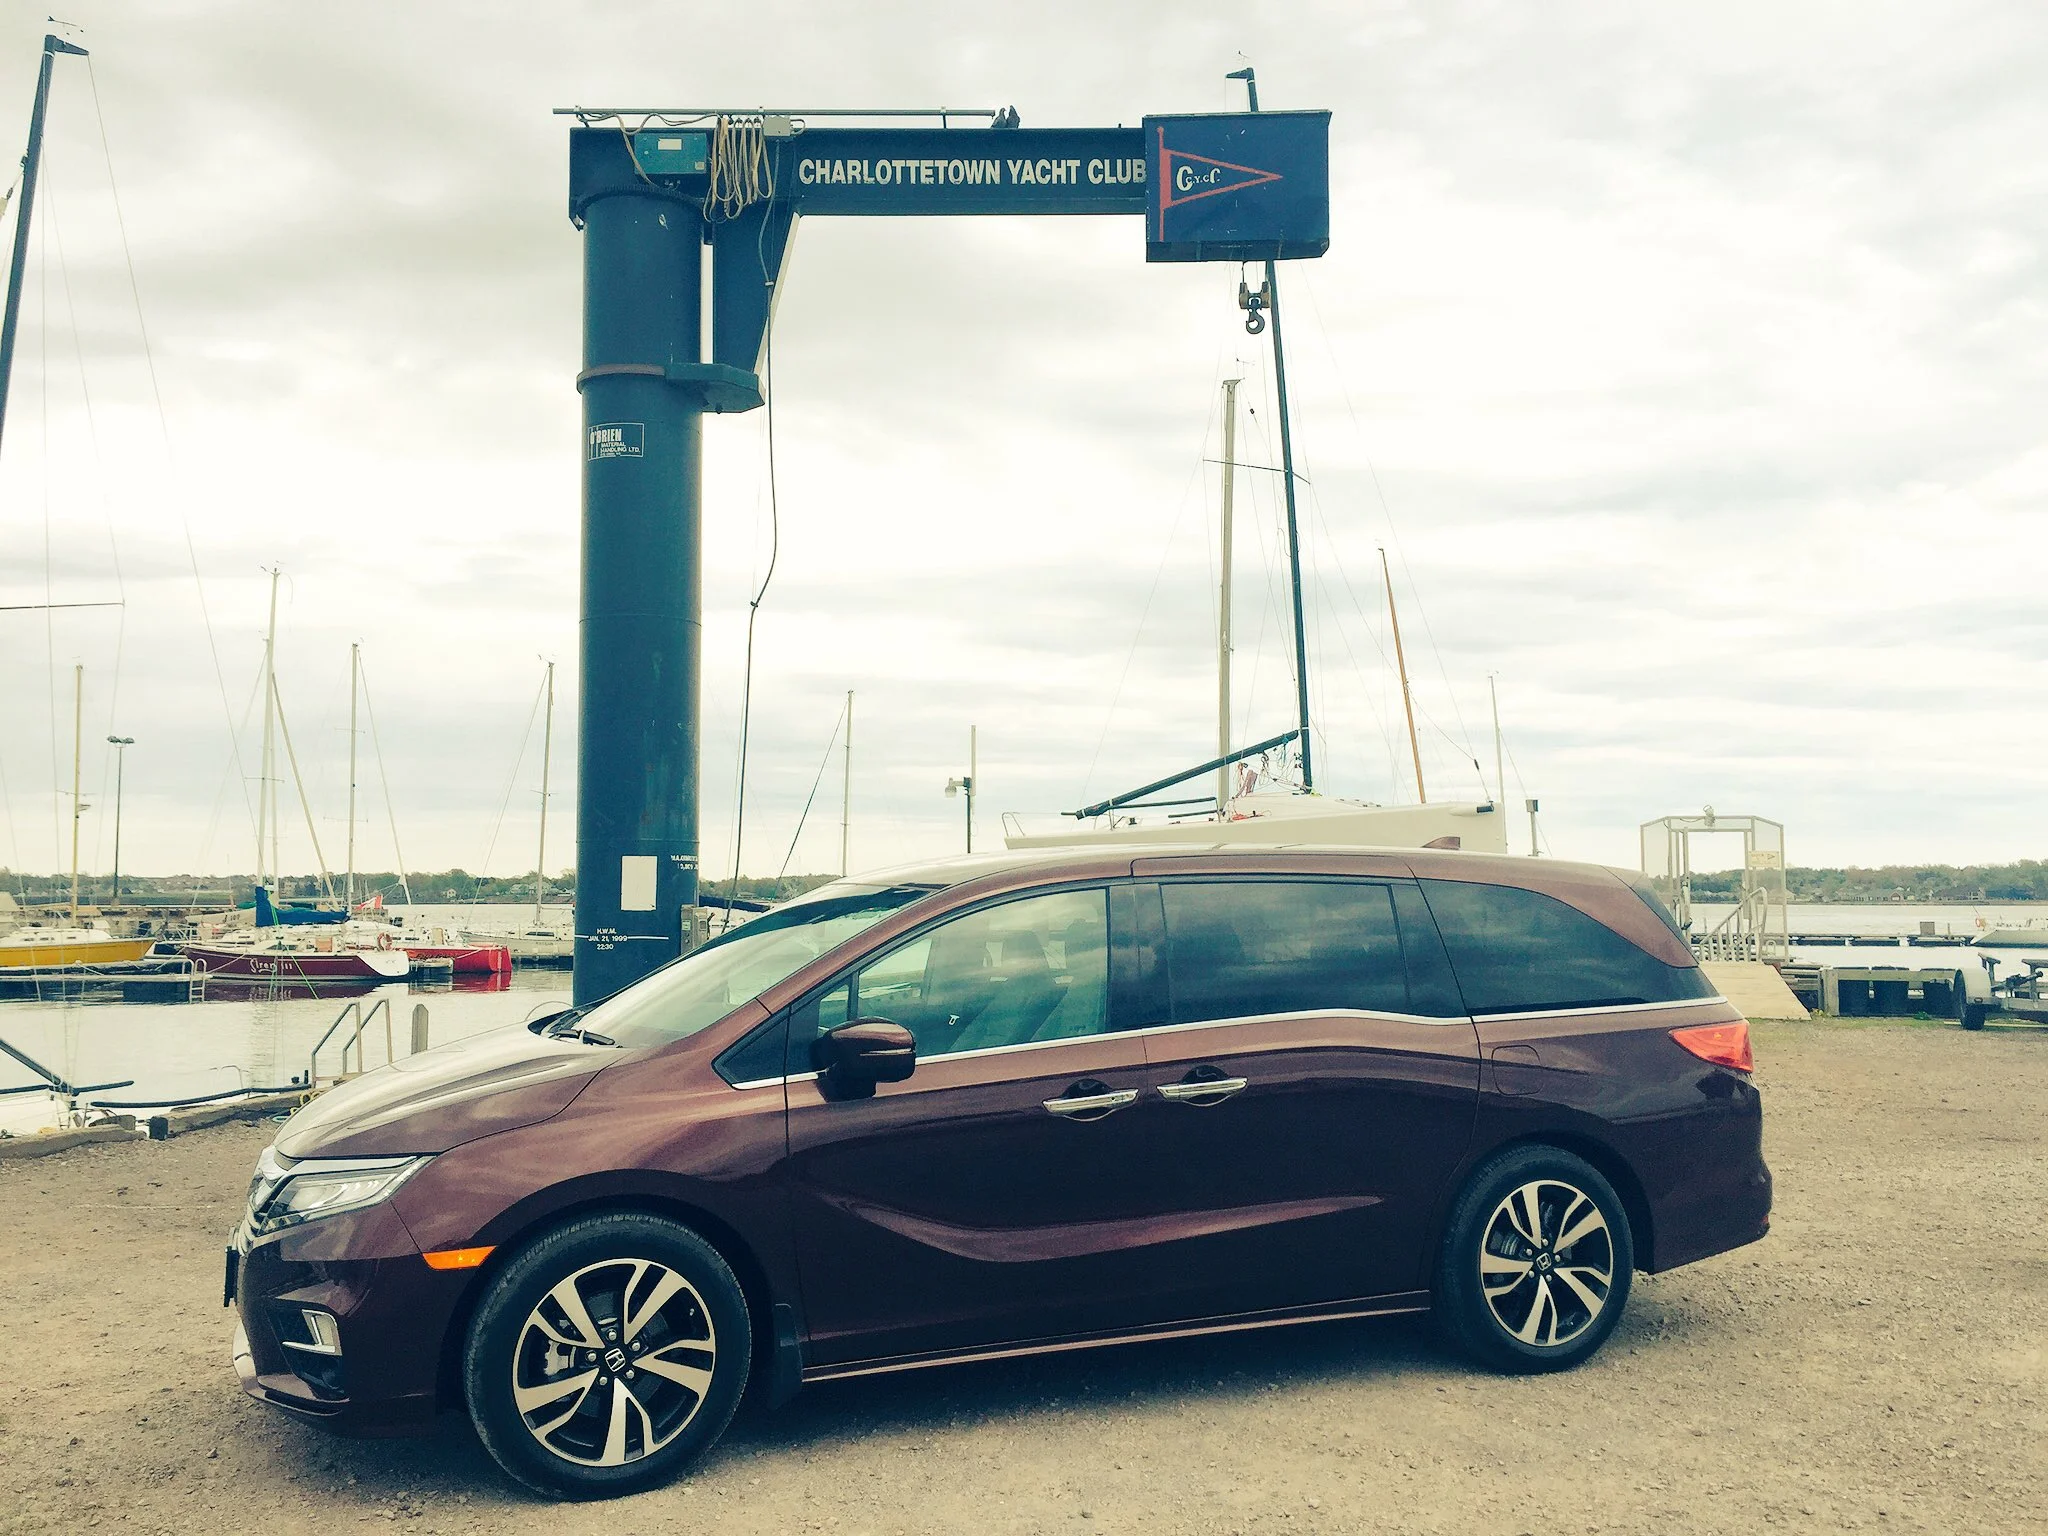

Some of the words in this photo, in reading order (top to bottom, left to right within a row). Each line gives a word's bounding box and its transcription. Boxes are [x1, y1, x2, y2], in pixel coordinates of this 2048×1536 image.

[799, 158, 1001, 184] CHARLOTTETOWN
[1007, 158, 1081, 185] YACHT
[1087, 158, 1147, 184] CLUB
[590, 428, 622, 444] O'BRIEN
